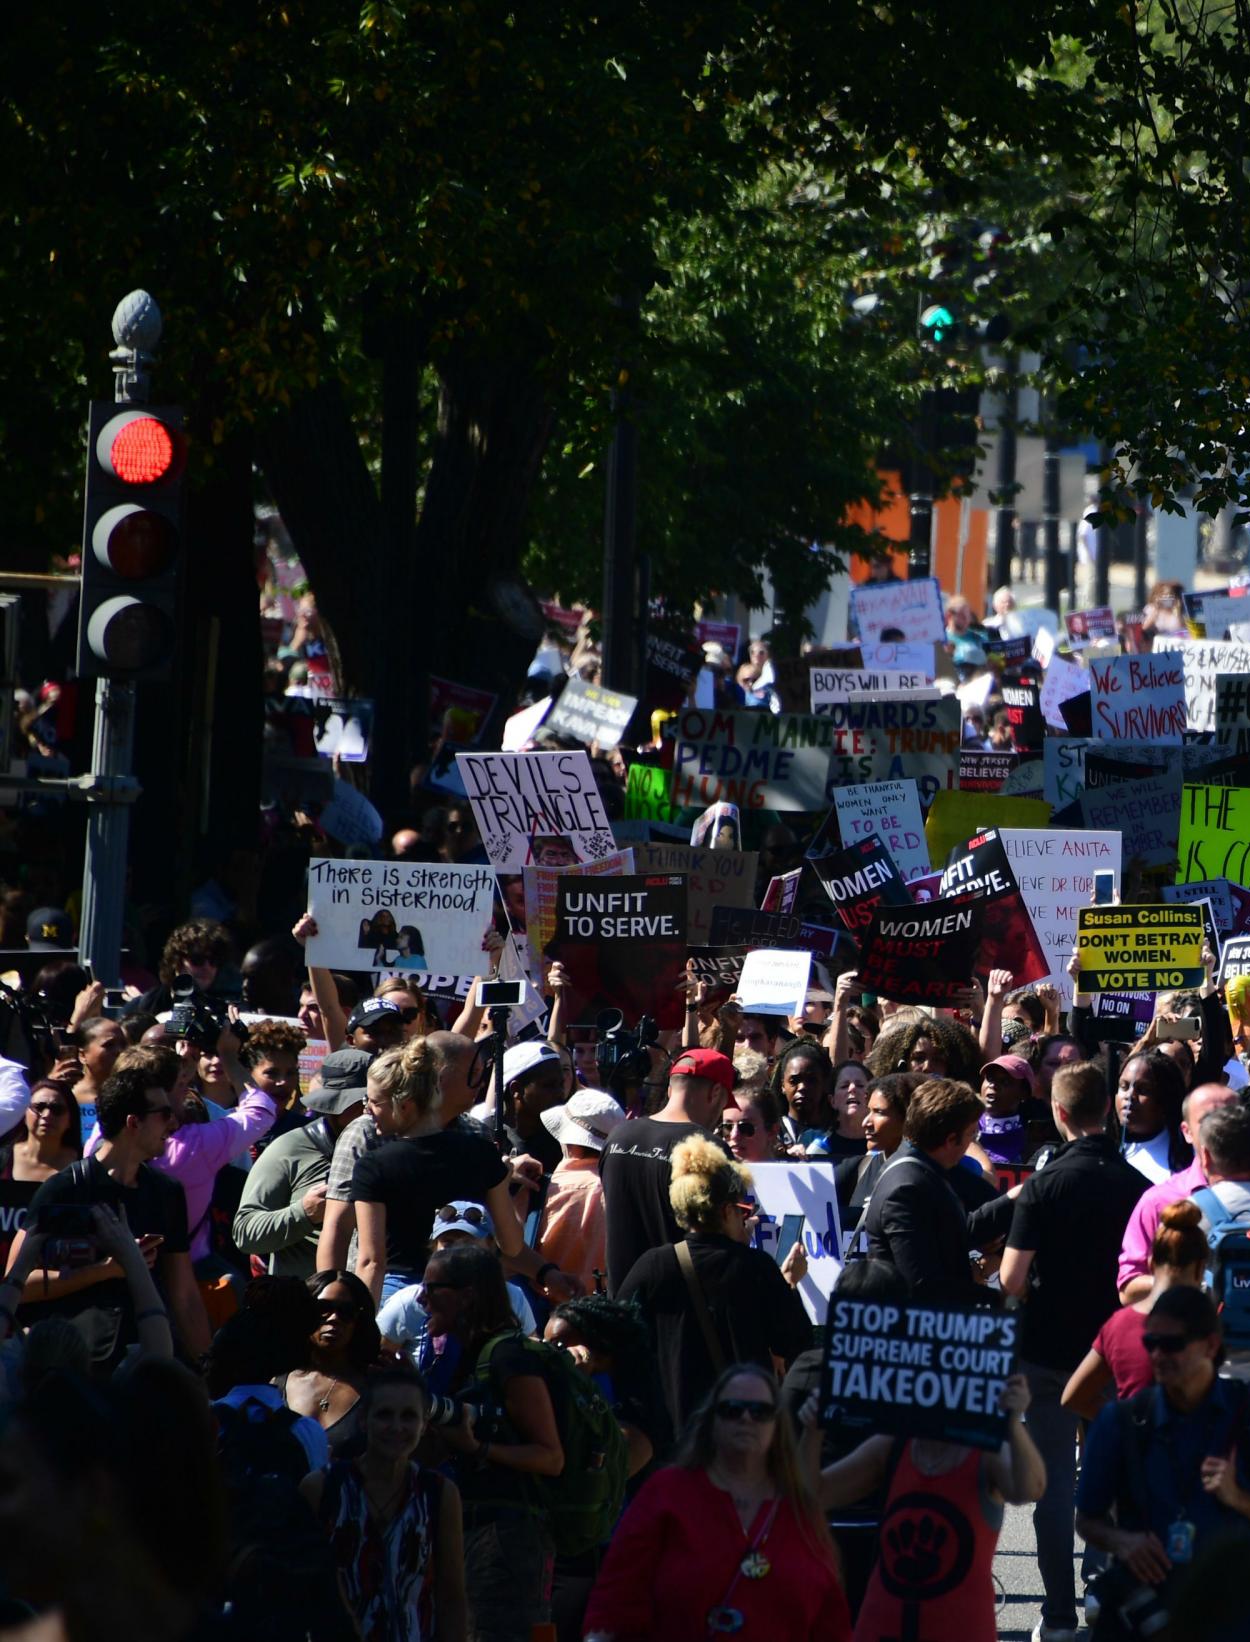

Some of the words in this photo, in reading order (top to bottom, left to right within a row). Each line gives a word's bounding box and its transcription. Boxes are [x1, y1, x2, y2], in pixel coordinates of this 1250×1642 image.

[813, 672, 856, 692] BOYS
[1091, 664, 1122, 695] We
[466, 755, 582, 796] DEVIL'S
[837, 756, 873, 779] IS
[959, 767, 1010, 779] BELIEVES
[471, 791, 609, 834] TRIANGLE
[836, 798, 872, 809] WOMEN
[861, 806, 888, 817] WANT
[1183, 786, 1240, 831] THE
[851, 819, 874, 835] TO
[881, 815, 902, 831] BE
[1006, 839, 1057, 858] ELIEVE
[1062, 841, 1112, 858] ANITA
[1184, 840, 1207, 884] IS
[311, 861, 373, 885] There
[332, 885, 350, 904] in
[565, 892, 649, 914] UNFIT
[564, 916, 594, 938] TO
[600, 915, 680, 938] SERVE.
[879, 909, 973, 938] WOMEN
[1085, 911, 1132, 926] Susan
[1138, 910, 1198, 924] Collins:
[872, 936, 945, 957] MUST
[1079, 933, 1130, 948] DON'T
[1136, 931, 1201, 947] BETRAY
[1104, 950, 1176, 964] WOMEN.
[1096, 974, 1149, 988] VOTE
[1156, 972, 1184, 986] NO
[1101, 1000, 1115, 1013] NO
[1116, 1001, 1130, 1014] ON
[834, 1301, 899, 1334] STOP
[905, 1309, 1016, 1347] TRUMP'S
[831, 1333, 934, 1367] SUPREME
[939, 1346, 1015, 1376] COURT
